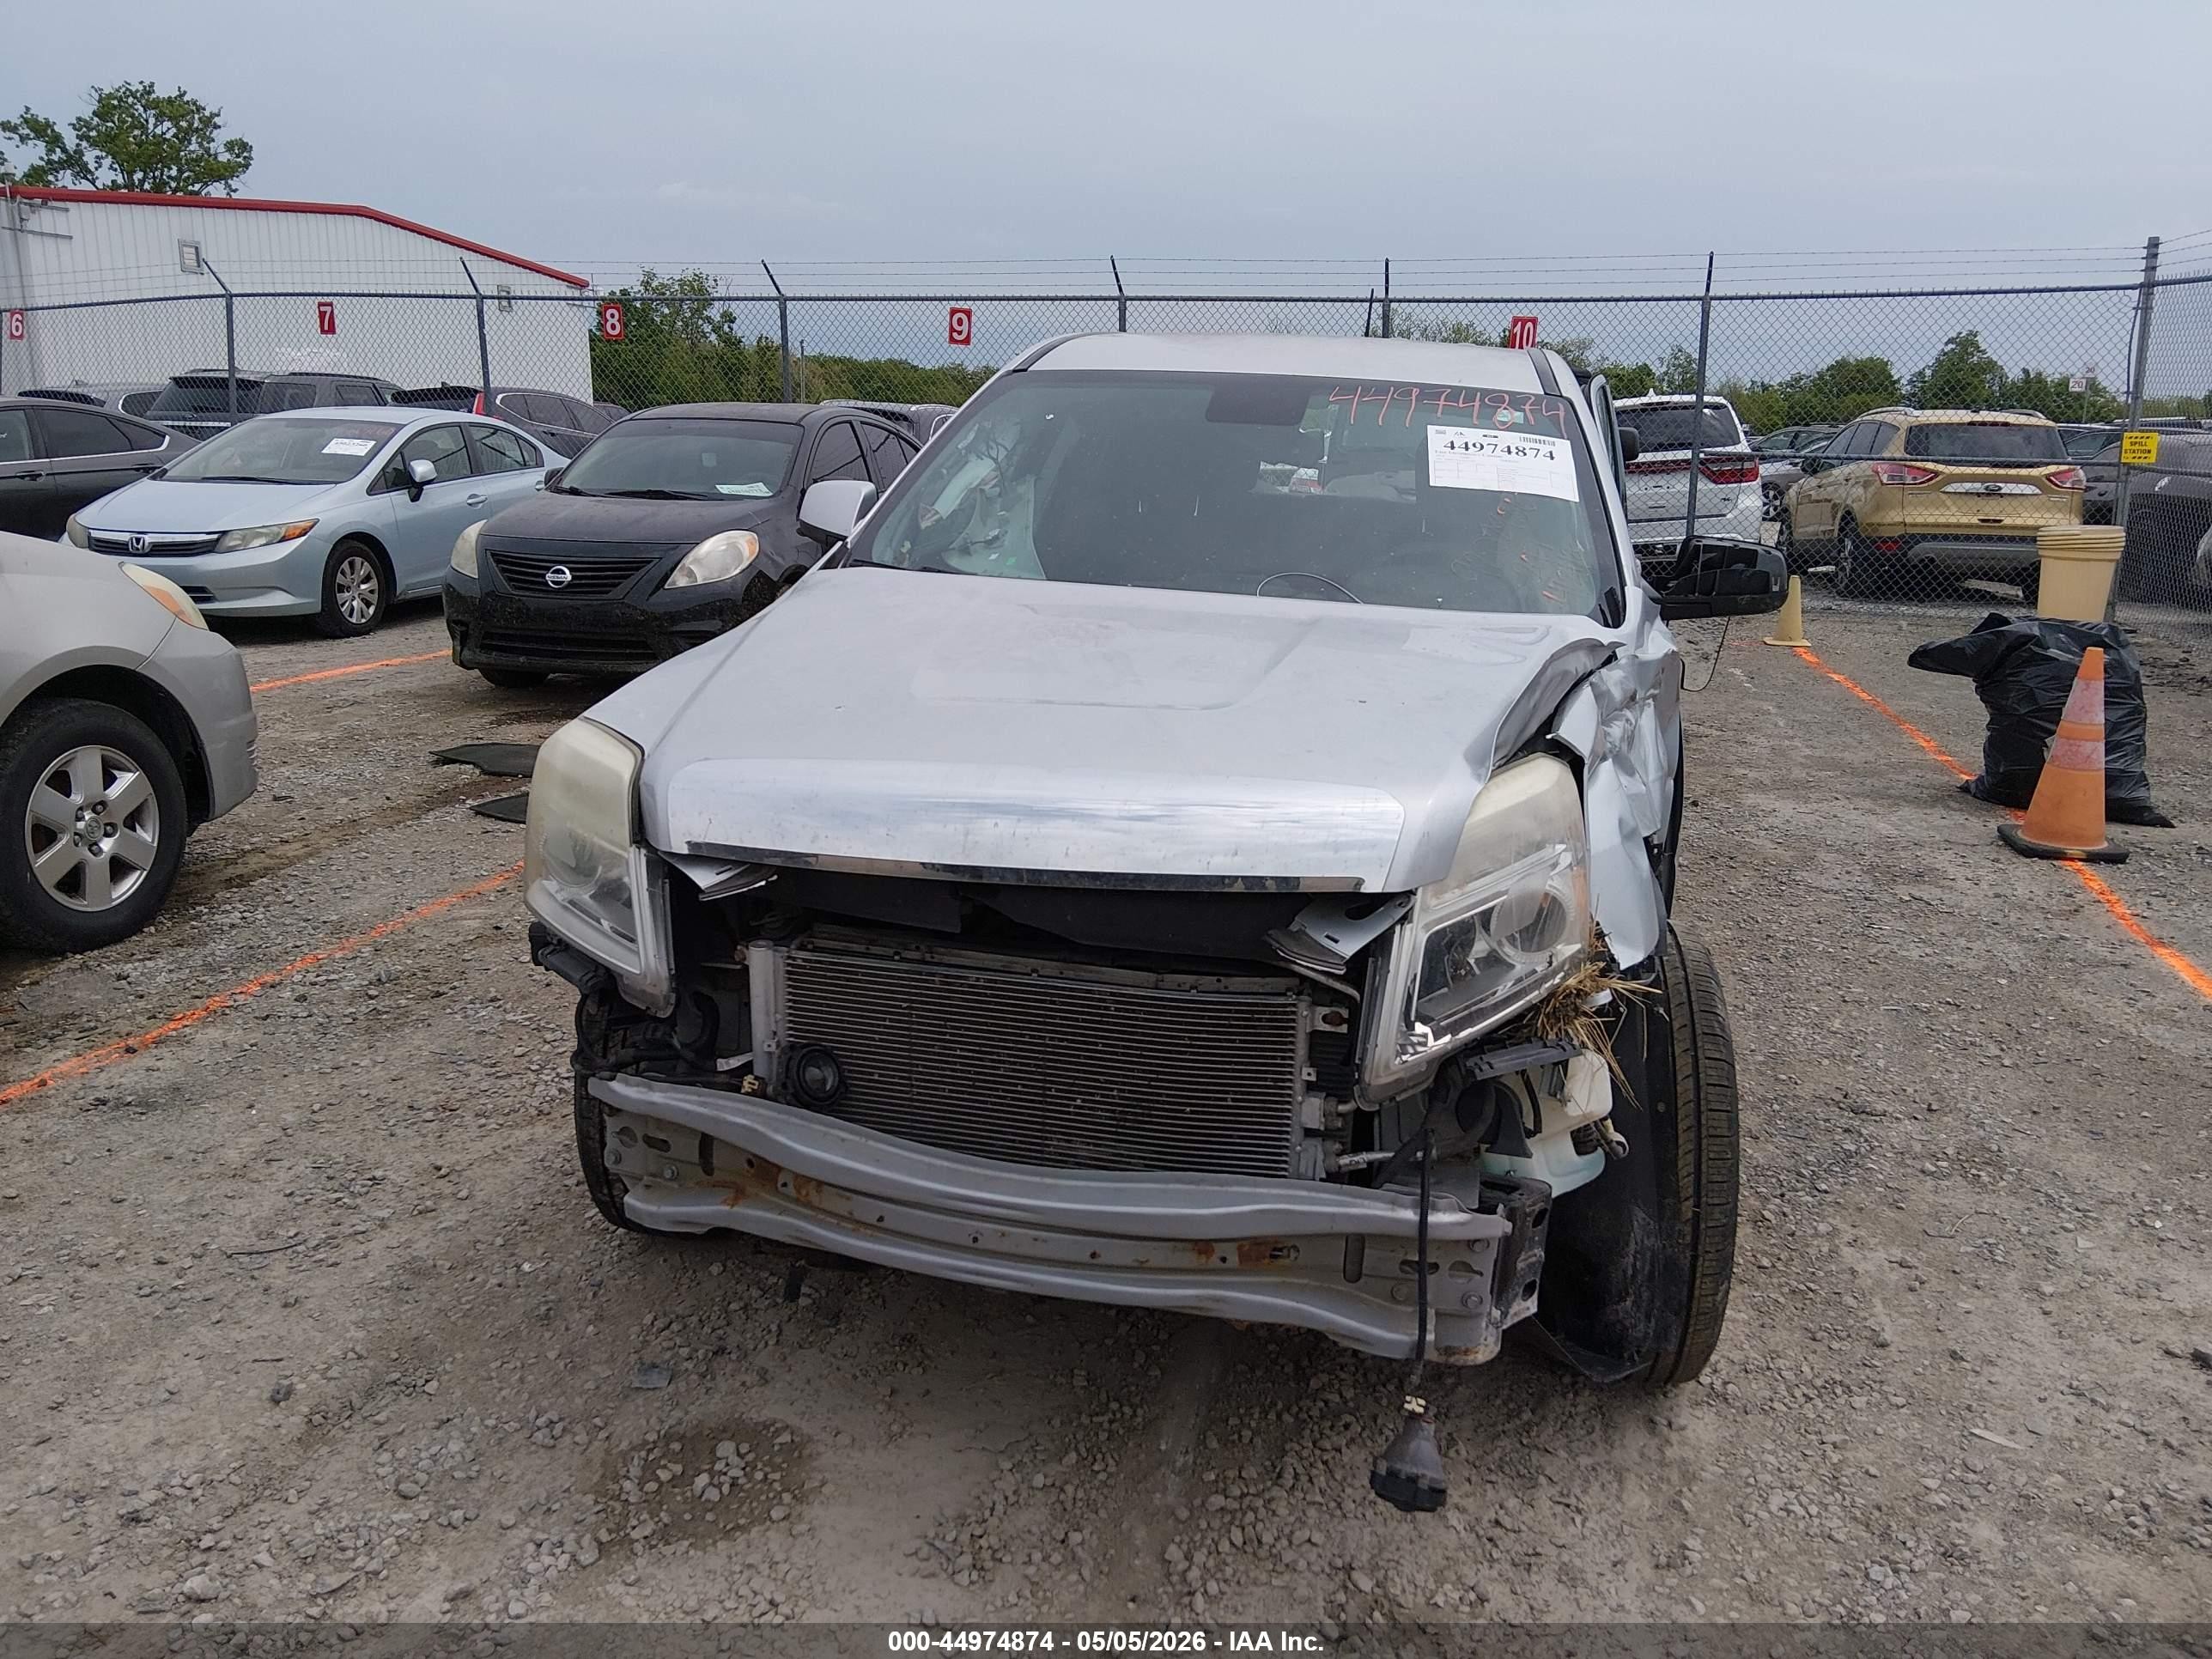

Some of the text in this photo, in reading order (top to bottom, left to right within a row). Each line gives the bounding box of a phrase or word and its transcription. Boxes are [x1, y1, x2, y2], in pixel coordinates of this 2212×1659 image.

[11, 313, 23, 337] 6
[319, 306, 332, 331] 7
[605, 308, 621, 335] 8
[951, 312, 969, 341] 9
[1513, 321, 1534, 349] 10
[2070, 380, 2084, 389] 20
[1328, 386, 1569, 440] 44974874
[1443, 439, 1557, 461] 44974874
